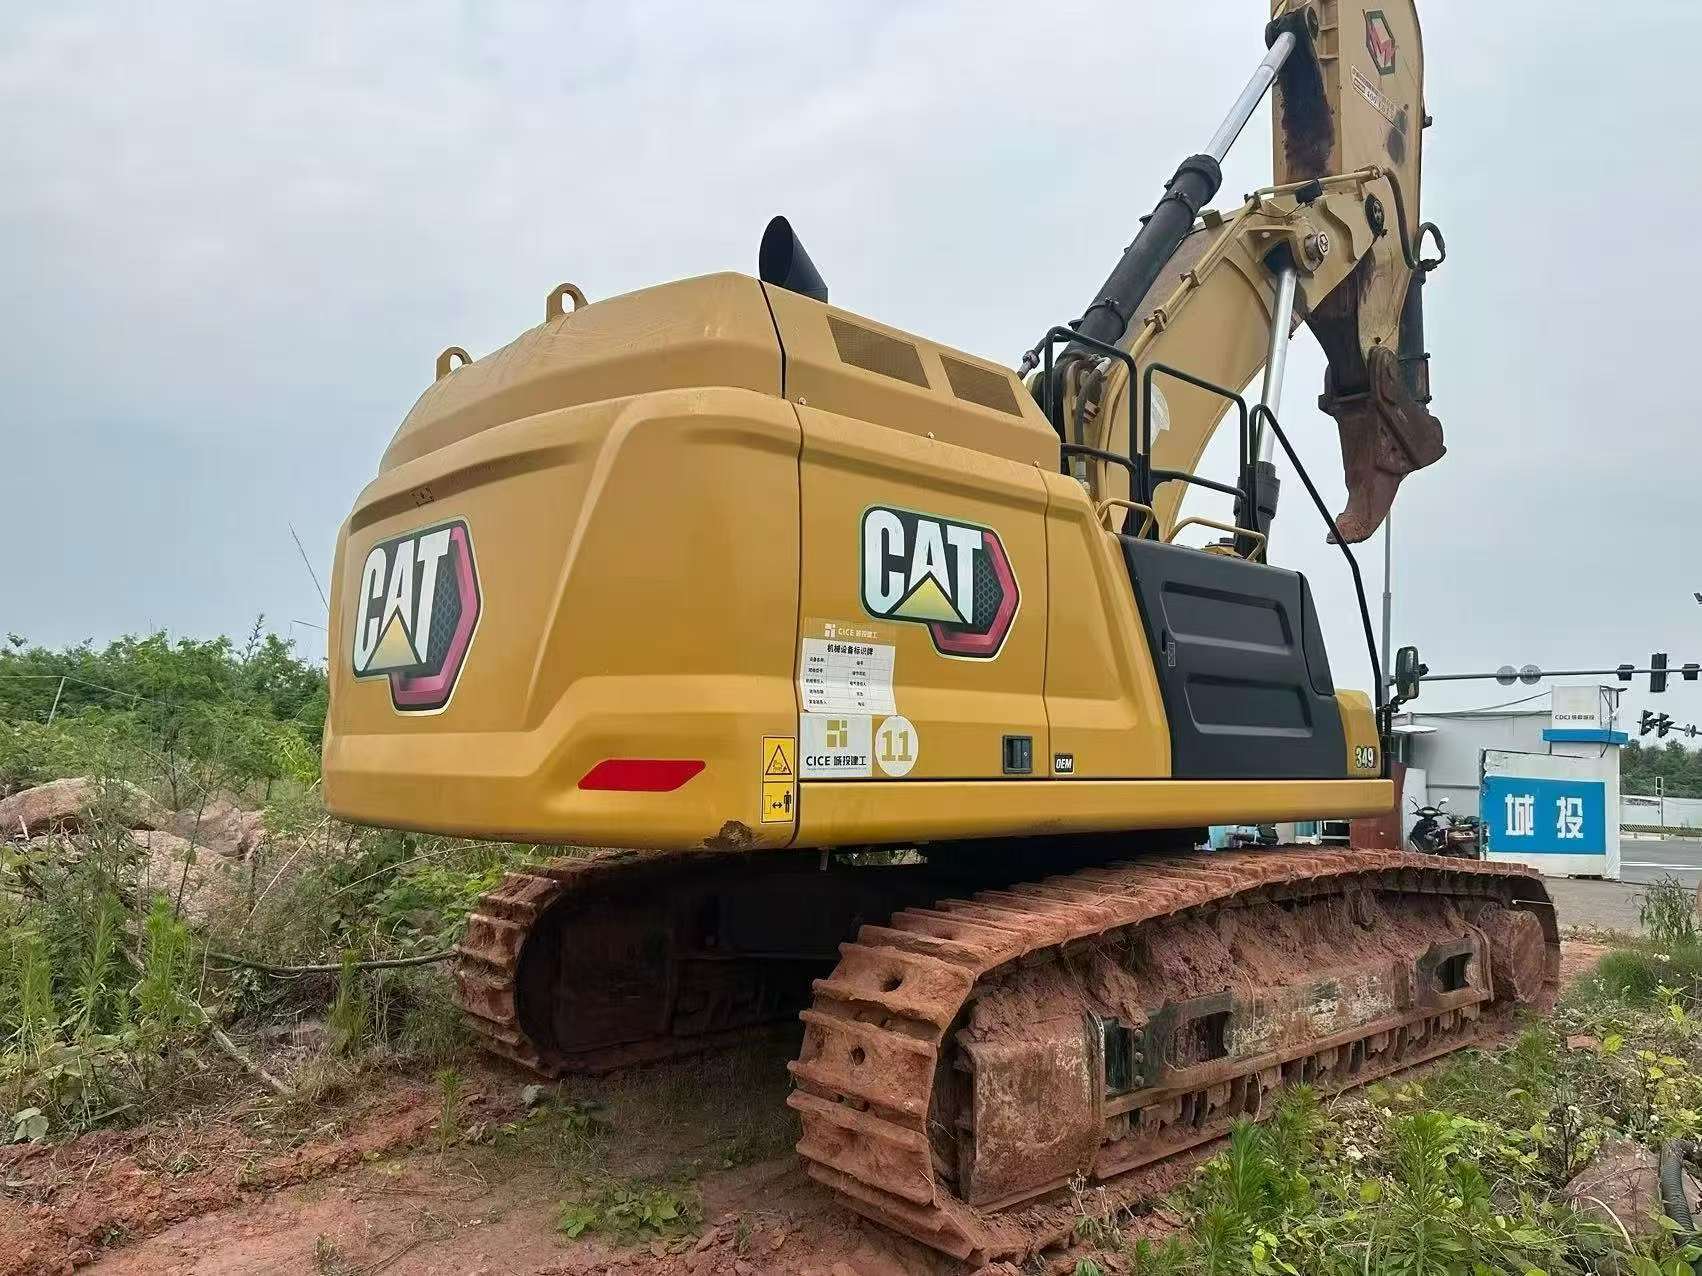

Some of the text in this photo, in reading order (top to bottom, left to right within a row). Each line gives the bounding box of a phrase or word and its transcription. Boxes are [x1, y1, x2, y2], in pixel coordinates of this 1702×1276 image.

[865, 509, 983, 624] CAT
[353, 528, 451, 671] CAT
[838, 628, 854, 637] CICE
[827, 644, 874, 656] 机械设备标识牌
[881, 730, 912, 762] 11
[806, 755, 867, 767] CICE 城投建工
[1055, 758, 1073, 769] OEM
[1356, 747, 1374, 768] 349
[1504, 793, 1584, 839] 城投
